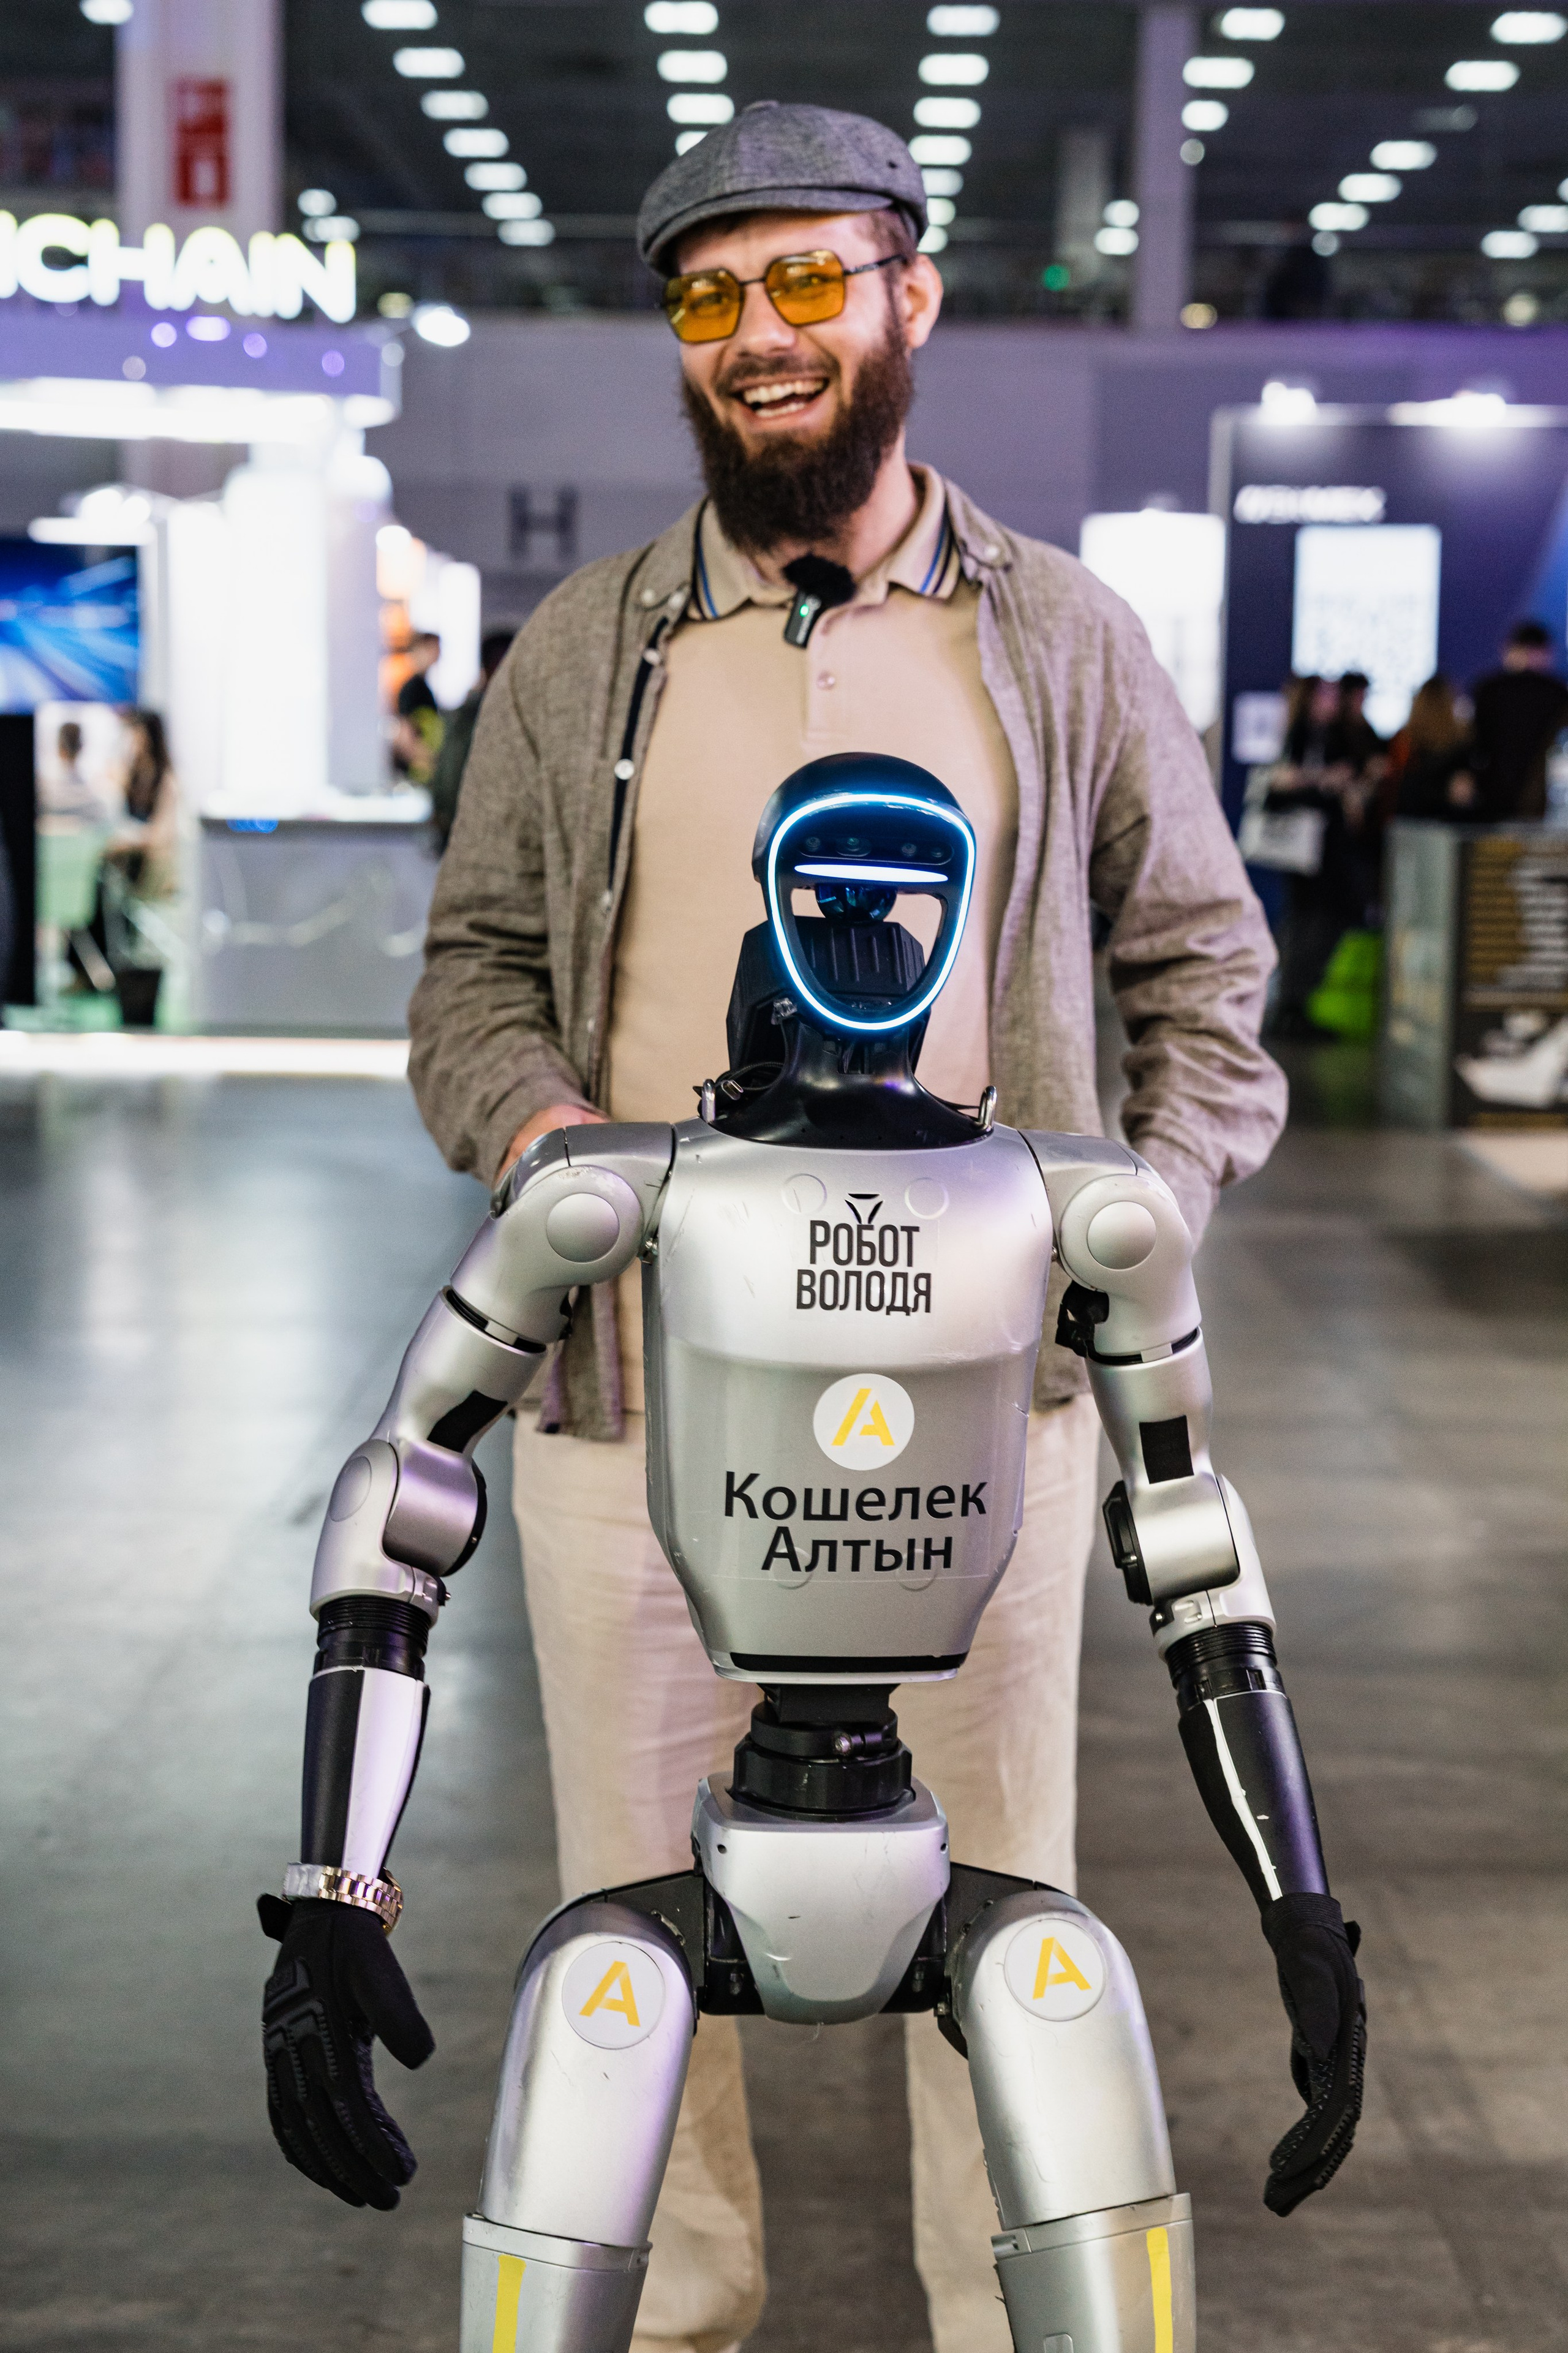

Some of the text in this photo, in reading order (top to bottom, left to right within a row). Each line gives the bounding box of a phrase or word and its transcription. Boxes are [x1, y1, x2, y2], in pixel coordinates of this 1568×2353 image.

[809, 1220, 921, 1267] РОБОТ
[796, 1269, 932, 1316] ВОЛОДЯ
[724, 1470, 989, 1522] Кошелек
[760, 1525, 954, 1573] Алтын
